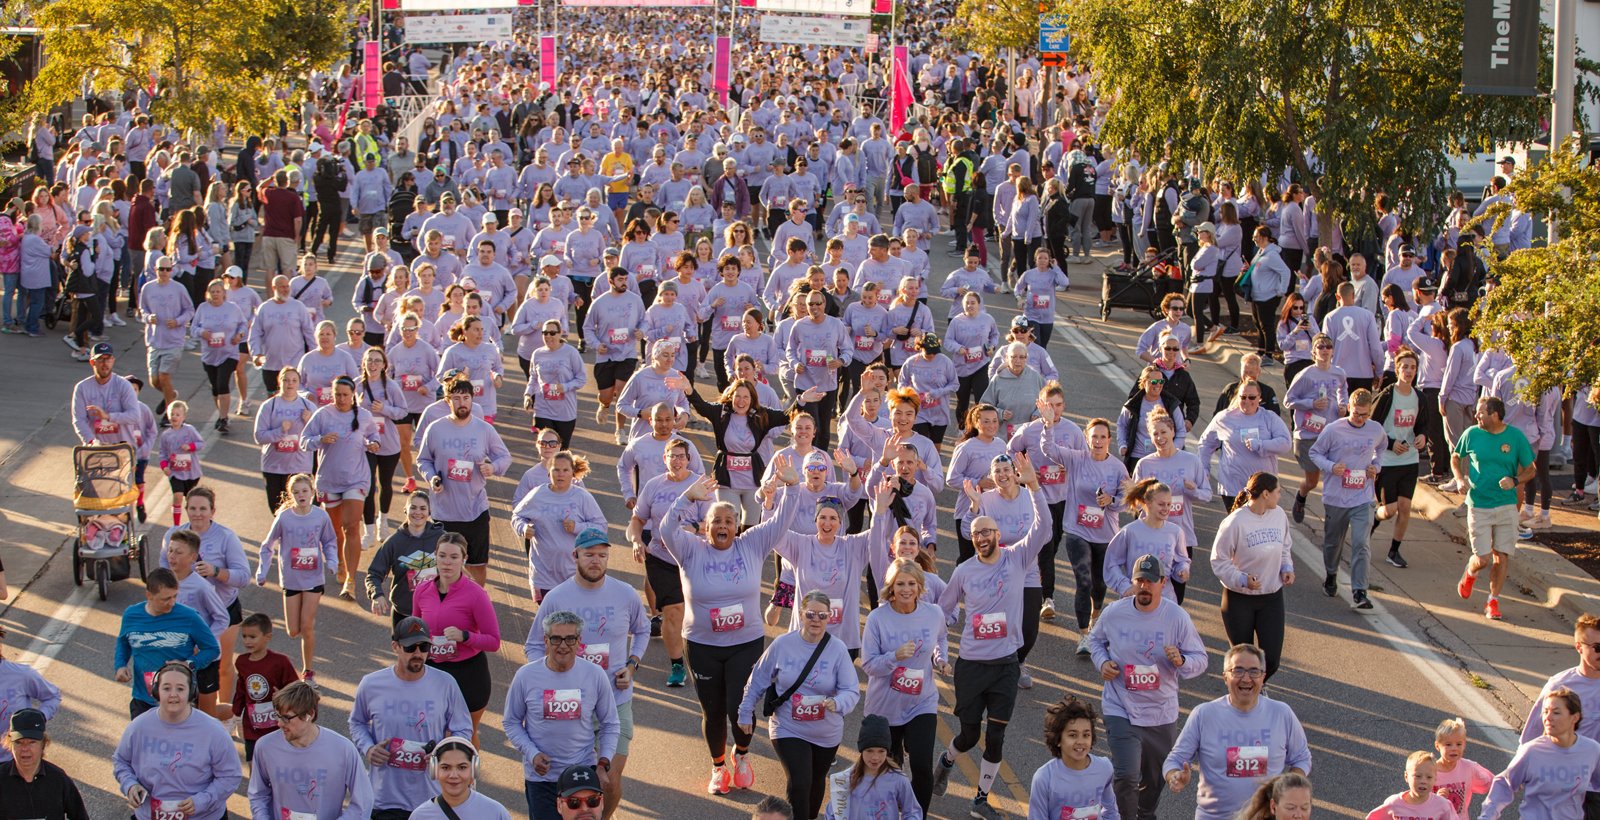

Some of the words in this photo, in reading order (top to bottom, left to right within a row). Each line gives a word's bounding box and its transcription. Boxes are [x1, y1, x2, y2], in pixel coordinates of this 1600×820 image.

[278, 439, 295, 448] 694
[729, 459, 750, 467] 1532
[450, 467, 469, 477] 444
[1044, 472, 1060, 480] 947
[1344, 476, 1364, 485] 1802
[1081, 514, 1099, 523] 509
[295, 556, 314, 565] 782
[714, 614, 742, 627] 1702
[978, 623, 1001, 634] 655
[429, 645, 455, 655] 1264
[897, 676, 920, 688] 409
[1129, 673, 1156, 685] 1100
[547, 701, 578, 713] 1209
[796, 705, 820, 715] 645
[395, 750, 422, 764] 236
[1235, 758, 1259, 771] 812
[154, 809, 185, 820] 1279
